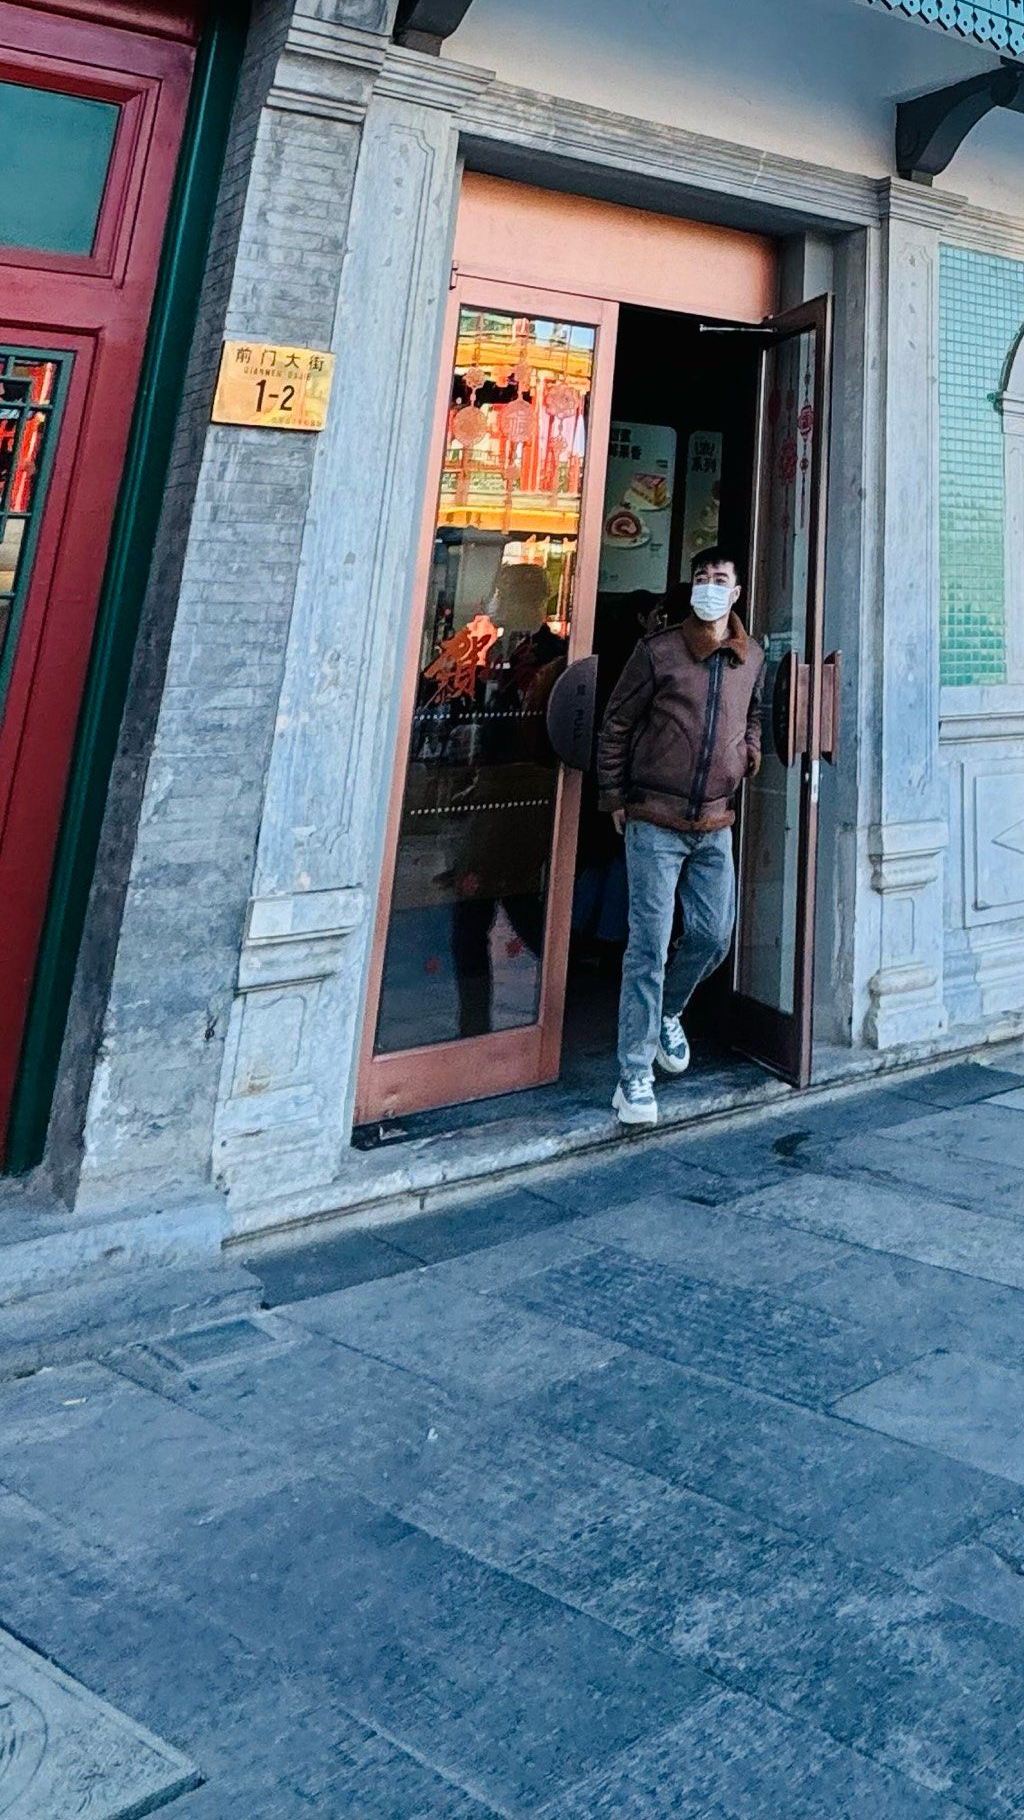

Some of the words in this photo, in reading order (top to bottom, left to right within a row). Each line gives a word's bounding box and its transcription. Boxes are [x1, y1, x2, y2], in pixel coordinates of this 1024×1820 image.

[235, 346, 325, 372] 前门大街
[243, 366, 282, 378] QIANMEN
[256, 379, 295, 412] 1-2
